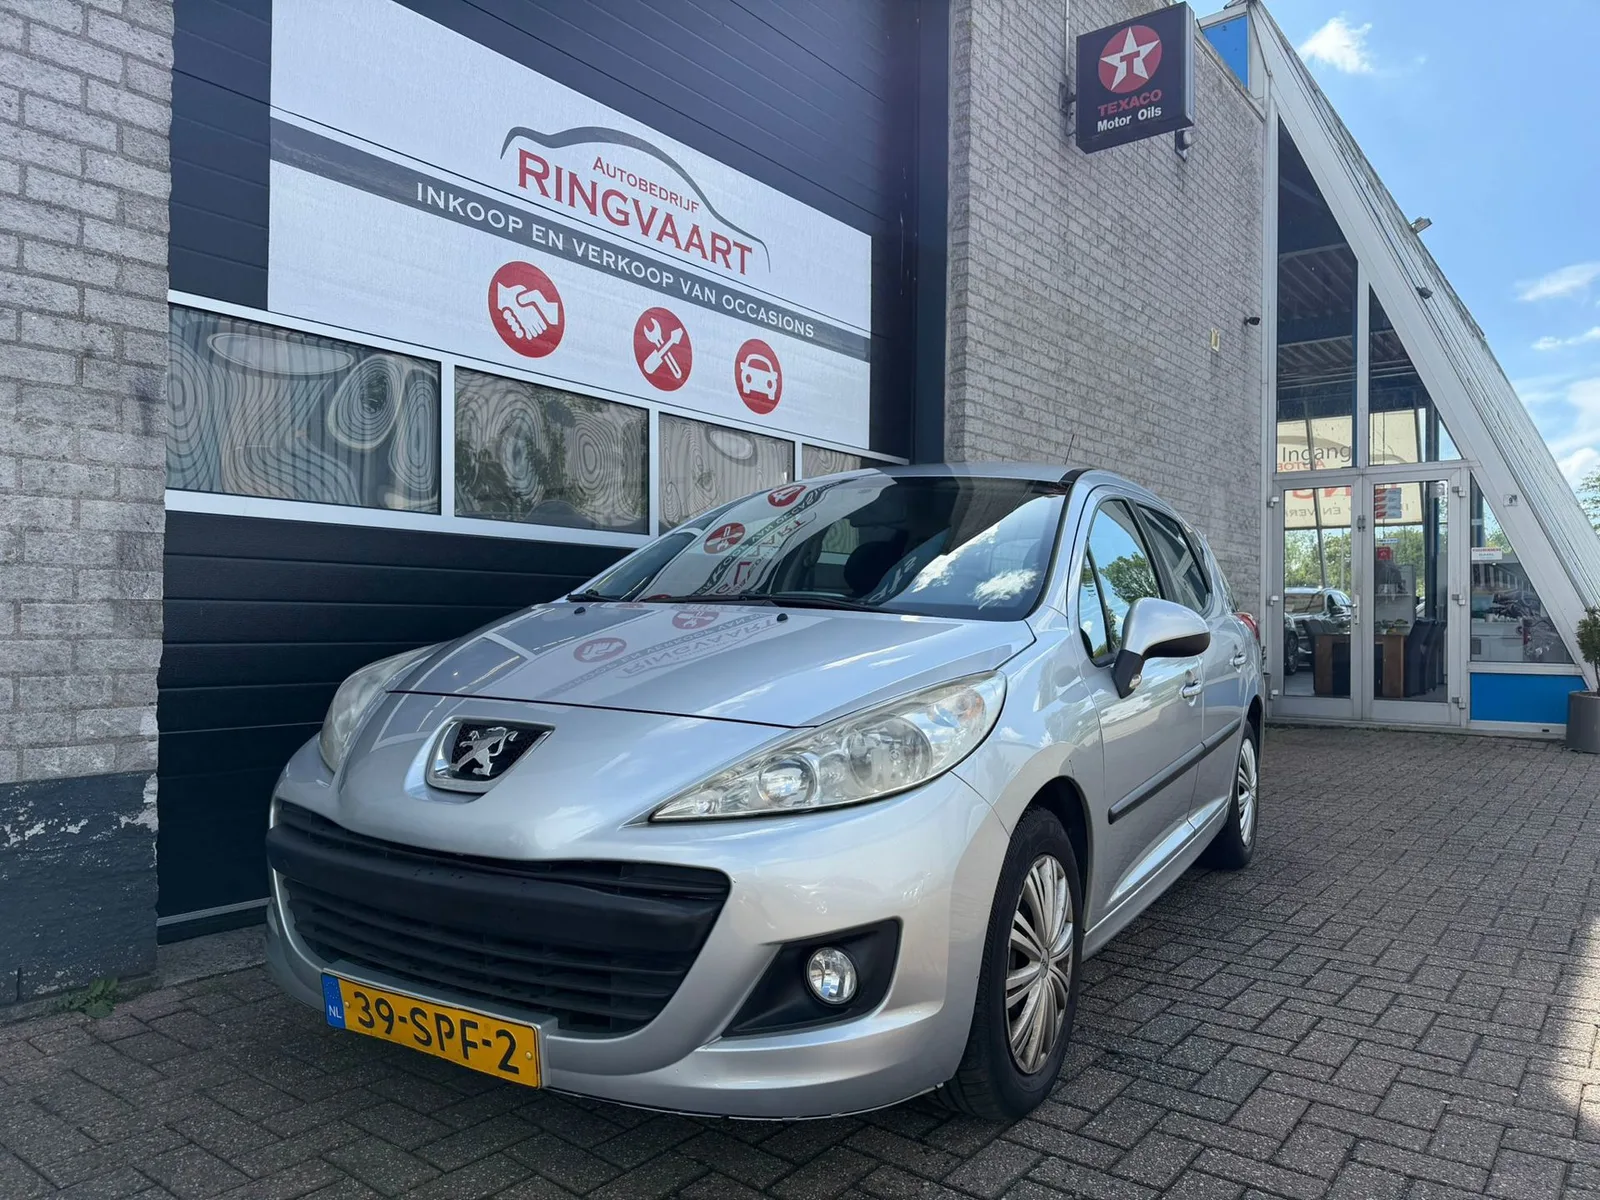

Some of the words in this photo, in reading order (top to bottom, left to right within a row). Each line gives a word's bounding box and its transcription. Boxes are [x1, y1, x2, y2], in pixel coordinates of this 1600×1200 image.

[1097, 89, 1162, 117] TEXACO
[1097, 115, 1132, 133] Motor
[1137, 106, 1162, 121] Oils
[592, 156, 700, 213] AUTOBEDRIJF
[518, 148, 753, 275] RINGVAART
[416, 182, 523, 234] INKOOP
[532, 225, 564, 251] EN
[573, 241, 675, 288] VERKOOP
[679, 276, 717, 305] VAN
[722, 295, 815, 338] OCCASIONS
[1282, 445, 1351, 470] Ingang
[328, 1004, 342, 1020] NL
[354, 991, 520, 1075] 39-SPF-2
